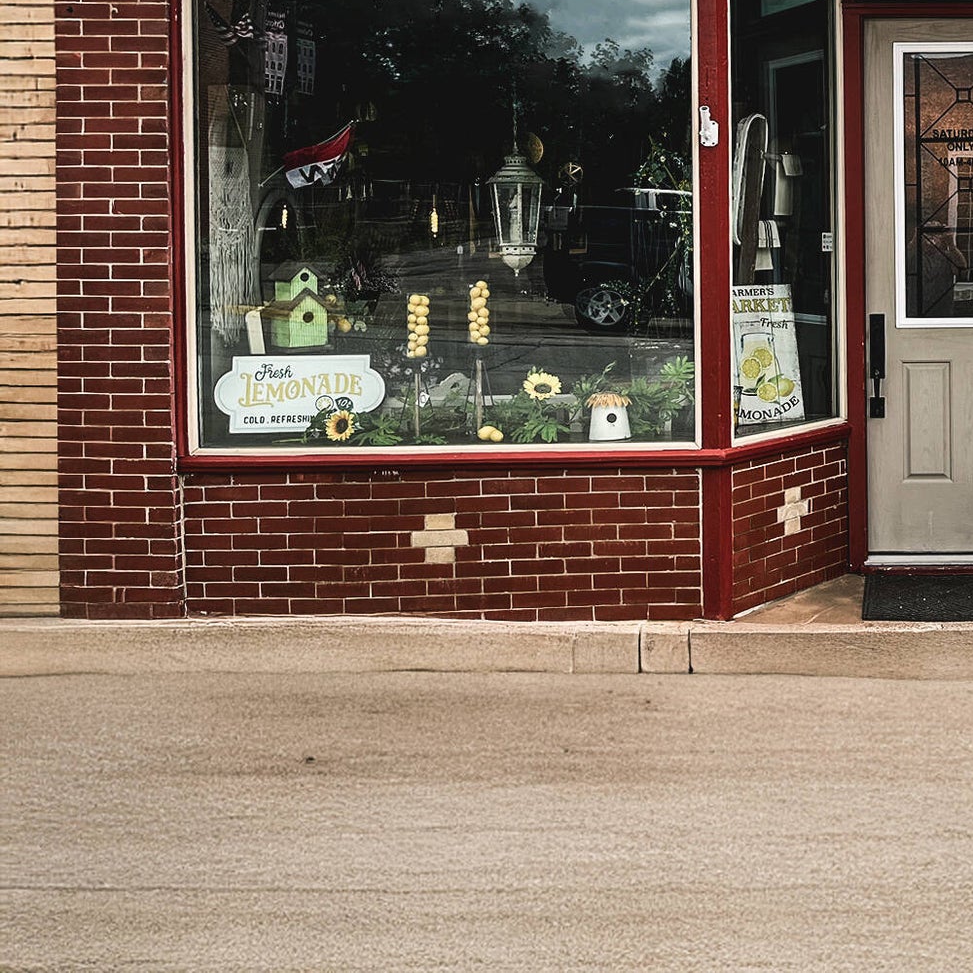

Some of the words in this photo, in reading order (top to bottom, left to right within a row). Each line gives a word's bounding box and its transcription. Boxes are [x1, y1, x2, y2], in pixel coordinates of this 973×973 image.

[760, 317, 788, 329] Fresh
[254, 363, 293, 382] Fresh
[238, 372, 363, 408] LEMONADE
